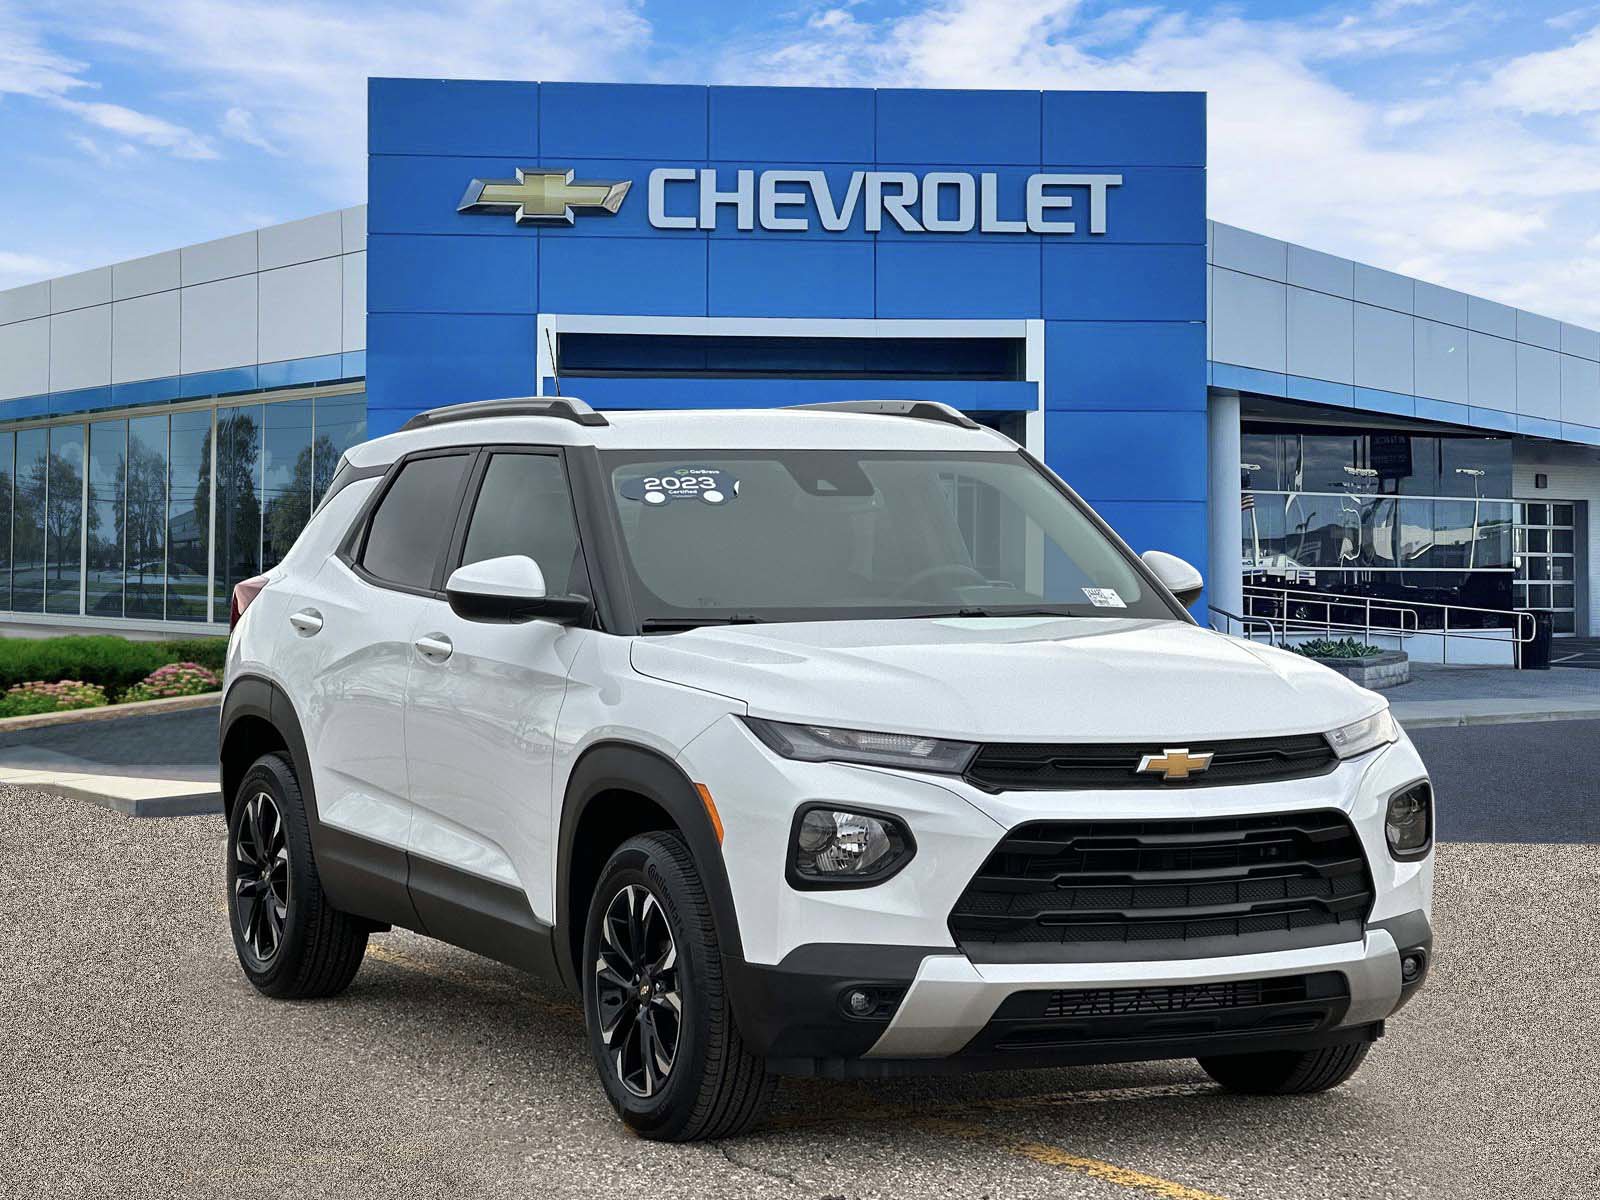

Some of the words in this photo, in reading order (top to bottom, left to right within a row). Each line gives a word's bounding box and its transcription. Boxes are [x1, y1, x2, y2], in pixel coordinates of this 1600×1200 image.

[648, 168, 1123, 234] CHEVROLET
[643, 476, 717, 490] 2023
[647, 863, 681, 927] Continental
